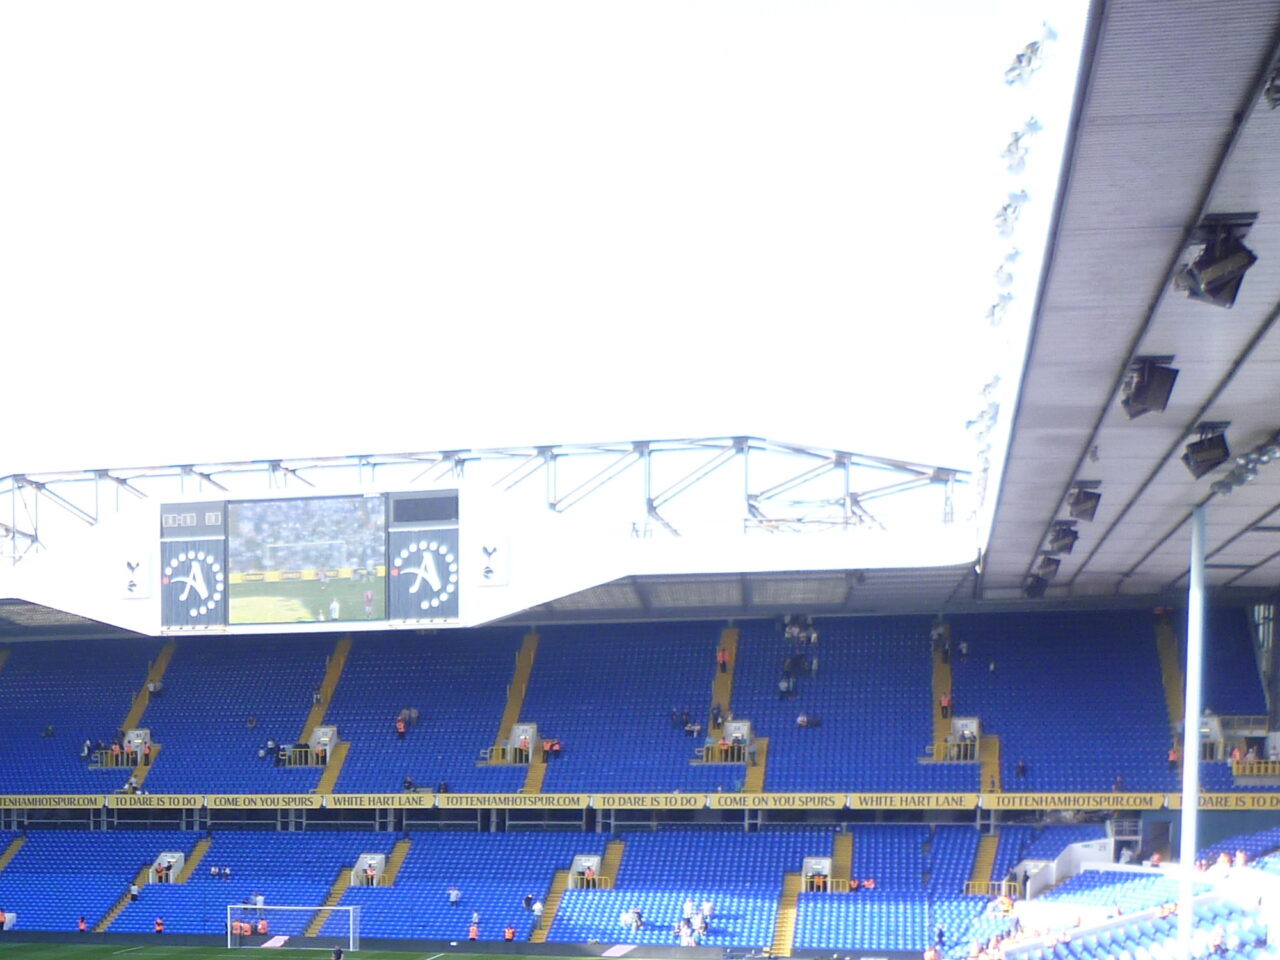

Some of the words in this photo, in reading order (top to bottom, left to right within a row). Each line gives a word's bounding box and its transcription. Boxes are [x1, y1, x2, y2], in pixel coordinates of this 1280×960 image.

[115, 797, 127, 806] TO
[130, 797, 154, 806] DARE
[156, 797, 165, 806] IS
[168, 797, 180, 806] TO
[183, 797, 196, 806] DO
[214, 797, 240, 806] COME
[243, 797, 257, 806] ON
[260, 797, 279, 806] YOU
[282, 797, 313, 806] SPURS
[333, 797, 365, 806] WHITE
[369, 797, 395, 806] HART
[399, 797, 424, 806] LANE
[446, 797, 580, 806] TOTTENHAMHOTSPUR.COM
[602, 797, 616, 806] TO
[619, 797, 647, 806] DARE
[651, 797, 660, 806] IS
[663, 797, 677, 806] TO
[680, 797, 697, 806] DO
[718, 797, 748, 806] COME
[752, 797, 768, 806] ON
[772, 797, 796, 806] YOU
[799, 797, 836, 806] SPURS
[859, 796, 897, 806] WHITE
[900, 796, 931, 806] HART
[936, 796, 965, 806] LANE
[996, 796, 1152, 807] TOTTENHAMHOTSPUR.COM
[1236, 796, 1246, 807] IS
[1251, 796, 1266, 807] TO
